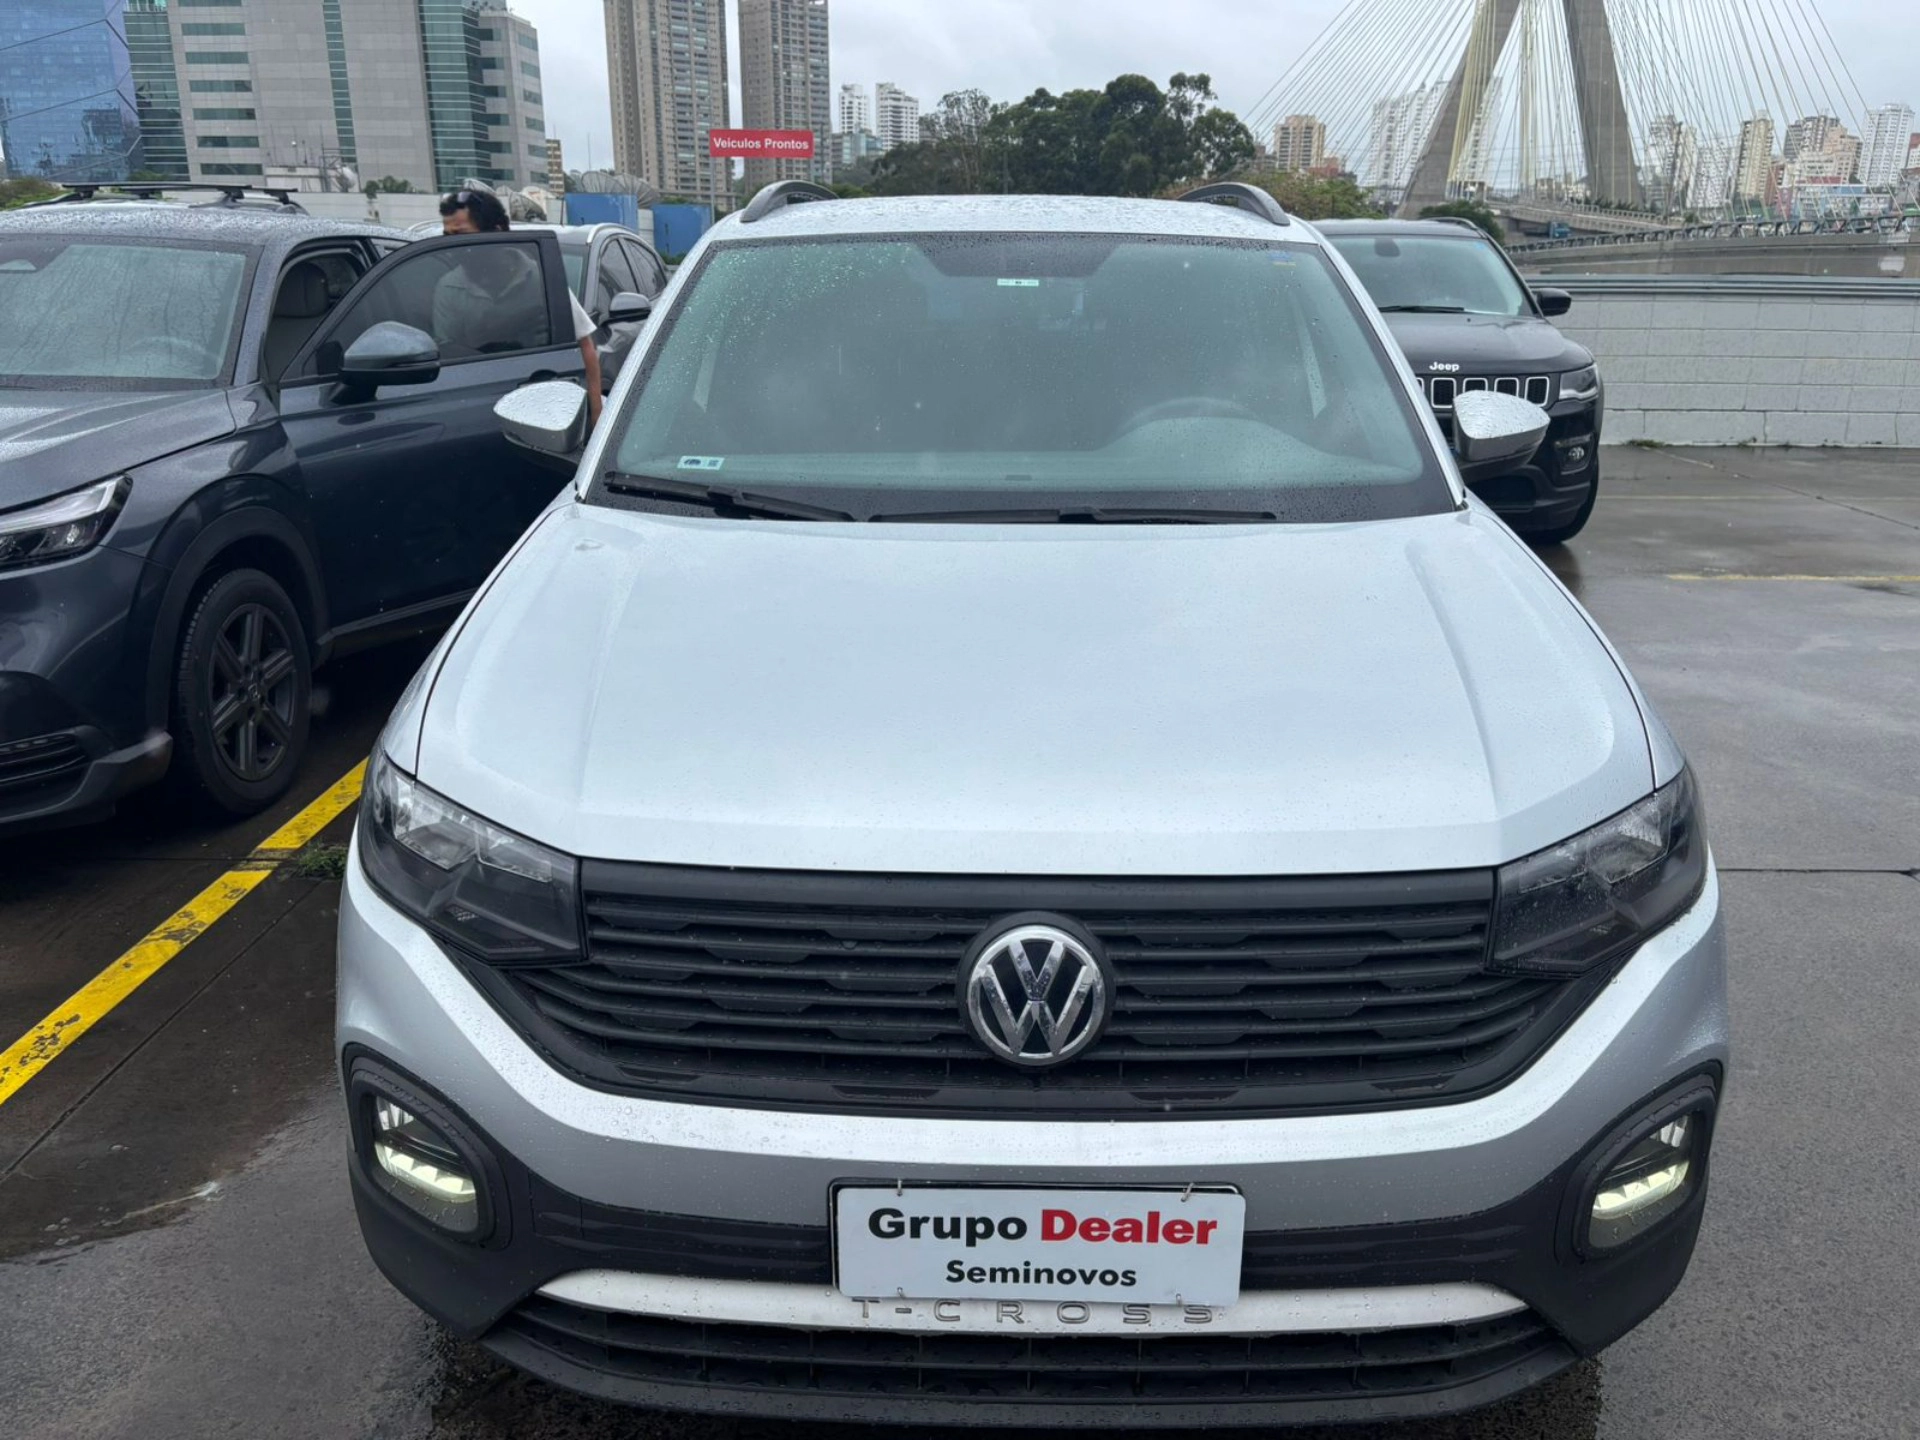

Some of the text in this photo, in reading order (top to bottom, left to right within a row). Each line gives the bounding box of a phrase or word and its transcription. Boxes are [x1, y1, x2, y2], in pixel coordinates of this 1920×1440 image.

[764, 138, 809, 150] Prontos
[1429, 361, 1460, 372] Jeep
[970, 928, 1104, 1064] VW
[868, 1207, 1218, 1248] Grupo Dealer
[945, 1259, 1137, 1287] Seminovos
[851, 1297, 1213, 1324] T-CROSS
